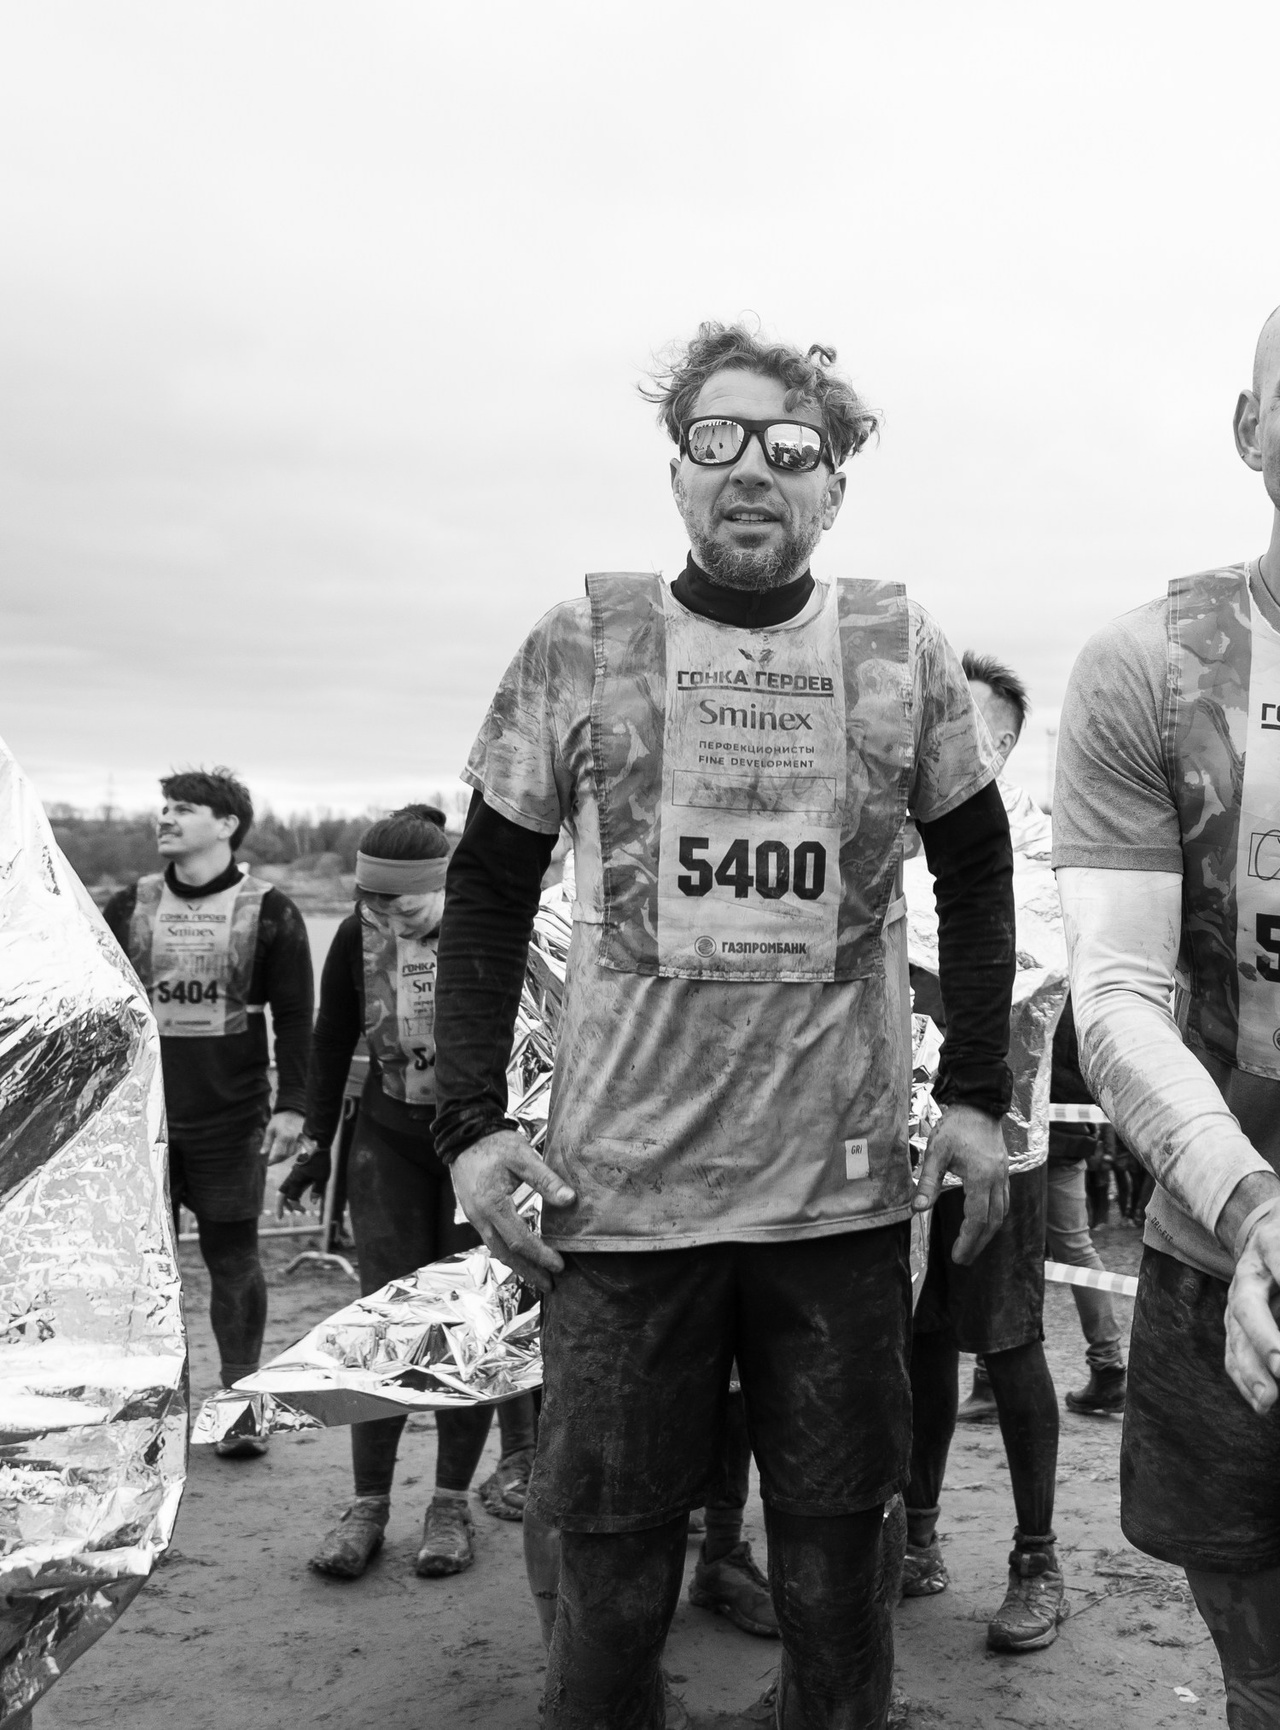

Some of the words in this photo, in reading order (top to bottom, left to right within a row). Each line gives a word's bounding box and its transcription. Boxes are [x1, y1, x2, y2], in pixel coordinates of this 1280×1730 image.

[677, 670, 748, 686] ГОНКА
[756, 671, 834, 691] ГЕРОЕВ
[699, 699, 813, 731] Sminex
[699, 740, 815, 754] ПЕРФЕКЦИОНИСТЫ
[698, 755, 725, 765] FINE
[731, 758, 815, 768] DEVELOPMENT
[677, 836, 827, 900] 5400
[721, 941, 807, 955] ГАЗПРОМБАНК
[158, 981, 218, 1004] 5404
